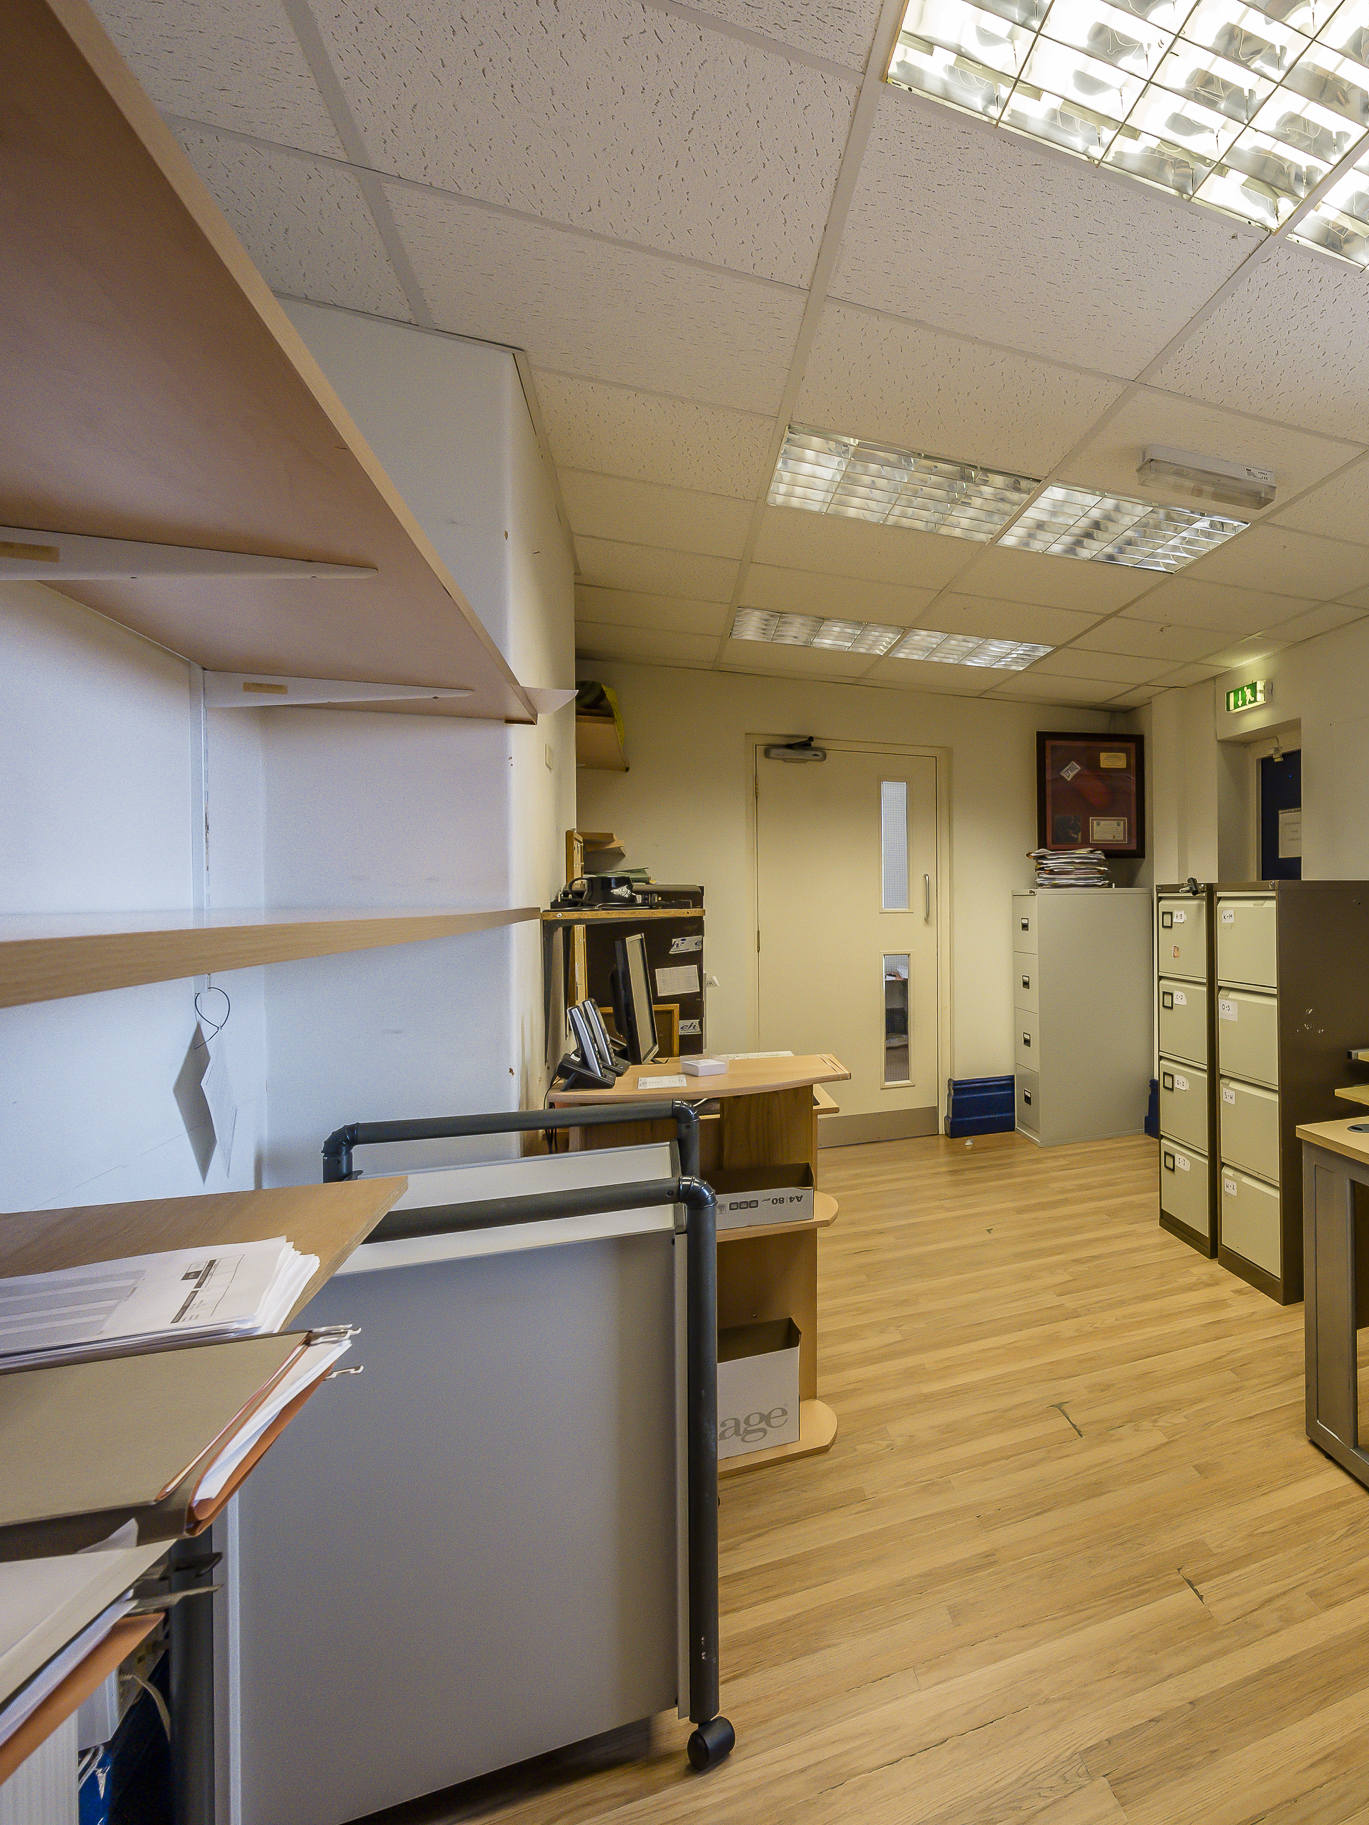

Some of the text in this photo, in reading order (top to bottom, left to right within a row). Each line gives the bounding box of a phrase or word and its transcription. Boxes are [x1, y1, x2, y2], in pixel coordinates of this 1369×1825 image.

[771, 1196, 785, 1205] 80
[788, 1194, 804, 1203] A4
[717, 1407, 788, 1443] age
